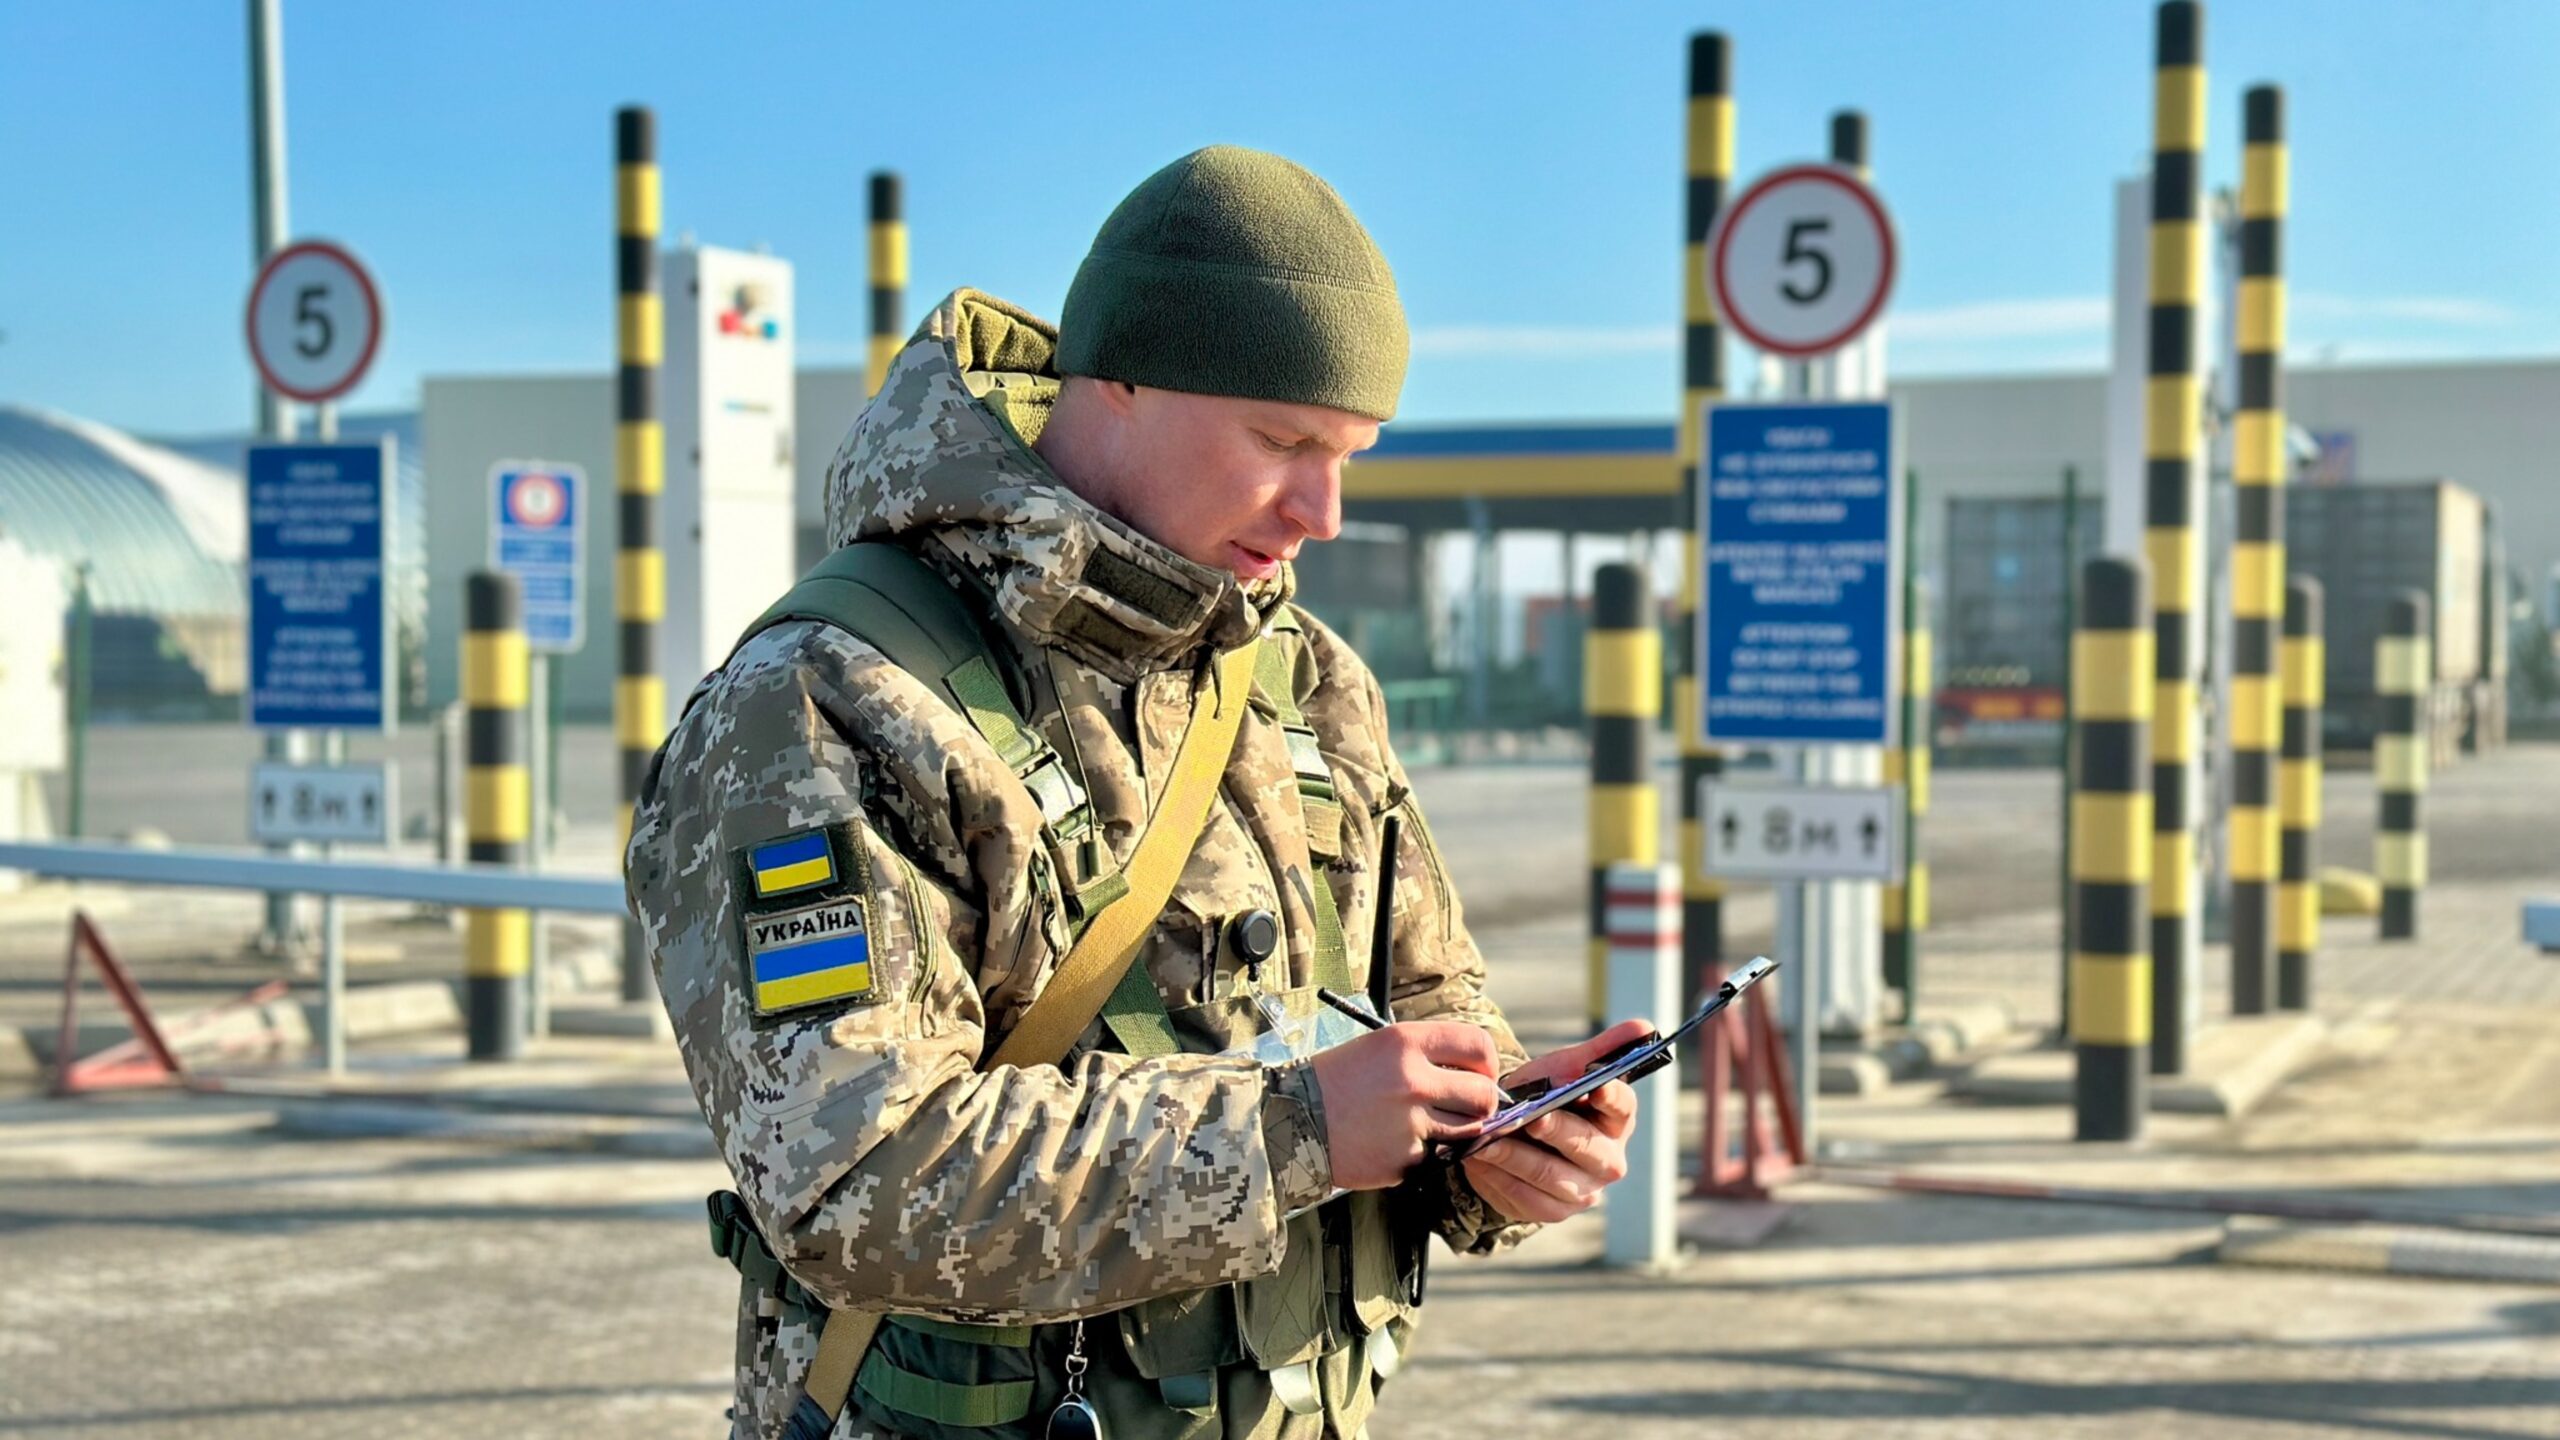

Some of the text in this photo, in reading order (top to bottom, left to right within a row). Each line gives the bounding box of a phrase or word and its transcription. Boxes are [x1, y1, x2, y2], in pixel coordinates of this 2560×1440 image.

[1780, 218, 1834, 306] 5
[295, 285, 334, 360] 5
[755, 910, 859, 945] УКРАЇНА
